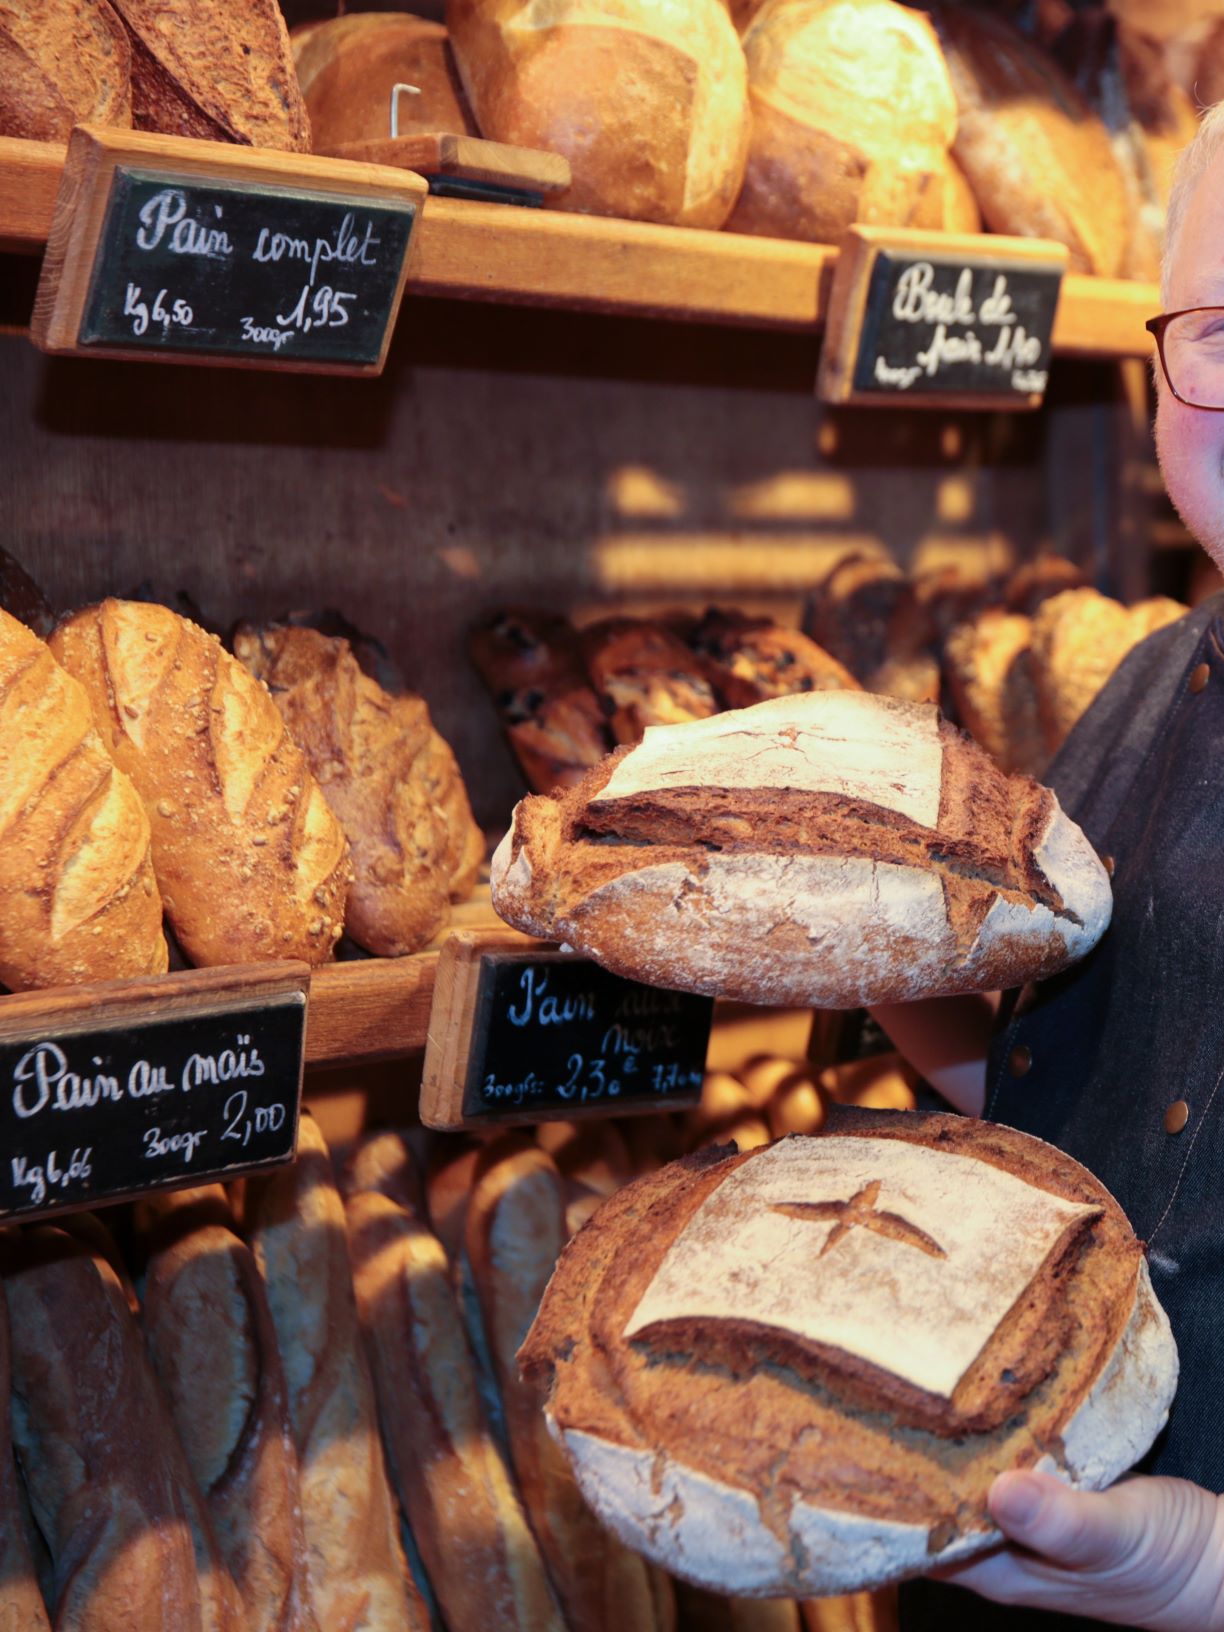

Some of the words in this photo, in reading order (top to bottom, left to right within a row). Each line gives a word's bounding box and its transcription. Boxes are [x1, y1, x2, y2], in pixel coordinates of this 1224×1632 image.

[136, 188, 234, 253] Pain
[252, 212, 381, 287] complet
[124, 282, 149, 336] Kg
[152, 288, 194, 326] 6,50
[240, 316, 296, 352] 300gr
[276, 284, 358, 334] 1,95
[979, 274, 1018, 325] de
[12, 1041, 124, 1119] Pain
[128, 1060, 175, 1098] au
[182, 1034, 266, 1092] maïs
[142, 1128, 208, 1163] 300gr
[219, 1090, 287, 1147] 2,00
[11, 1156, 47, 1205] Kg
[47, 1147, 94, 1188] 6,66
